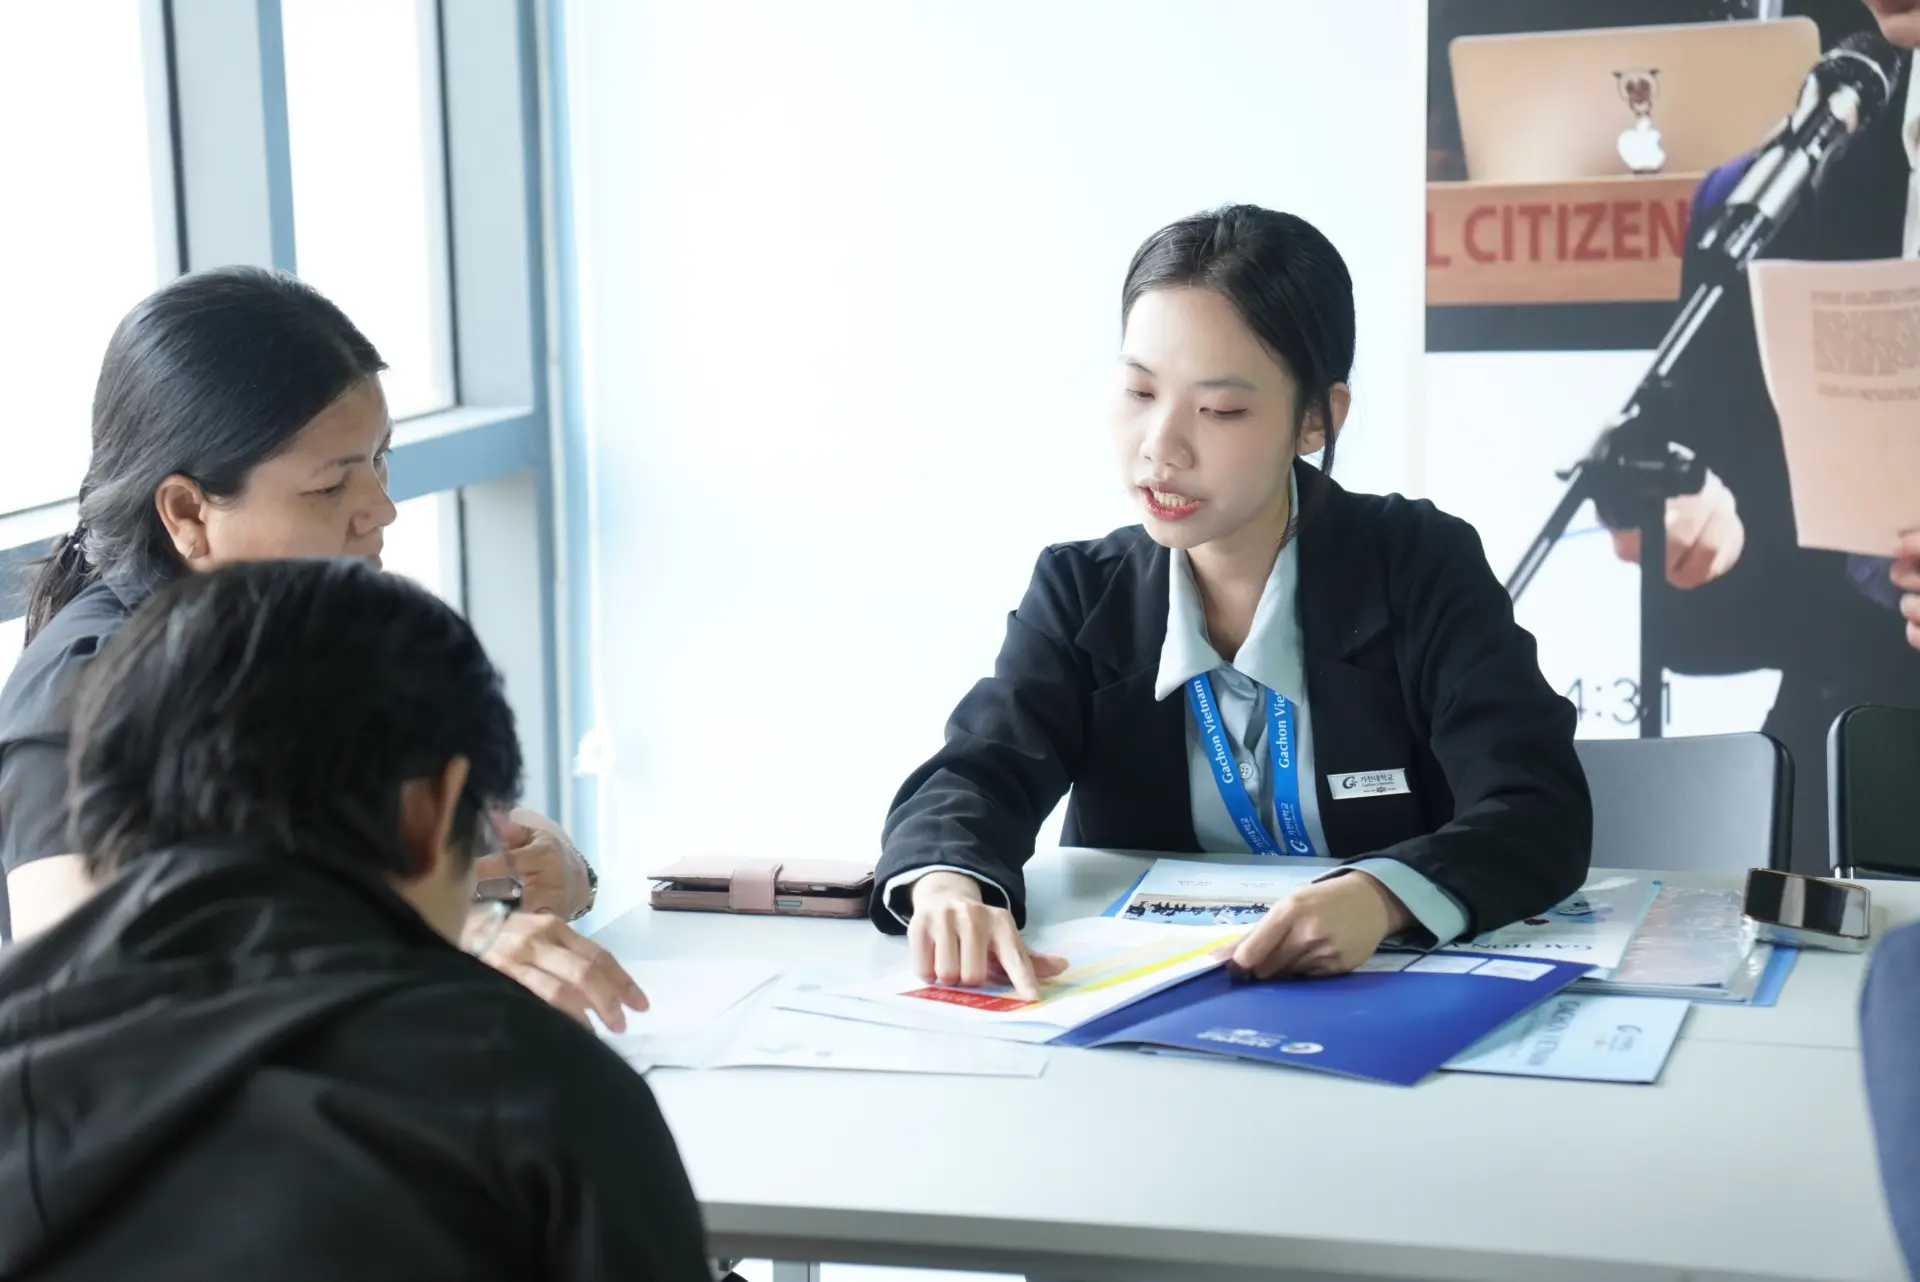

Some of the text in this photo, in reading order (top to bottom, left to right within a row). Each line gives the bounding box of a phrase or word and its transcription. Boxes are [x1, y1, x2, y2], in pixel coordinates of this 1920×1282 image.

[1463, 199, 1689, 264] CITIZEN
[1194, 680, 1234, 784] Gachon Vietnam
[1274, 691, 1290, 768] Gachon Vie
